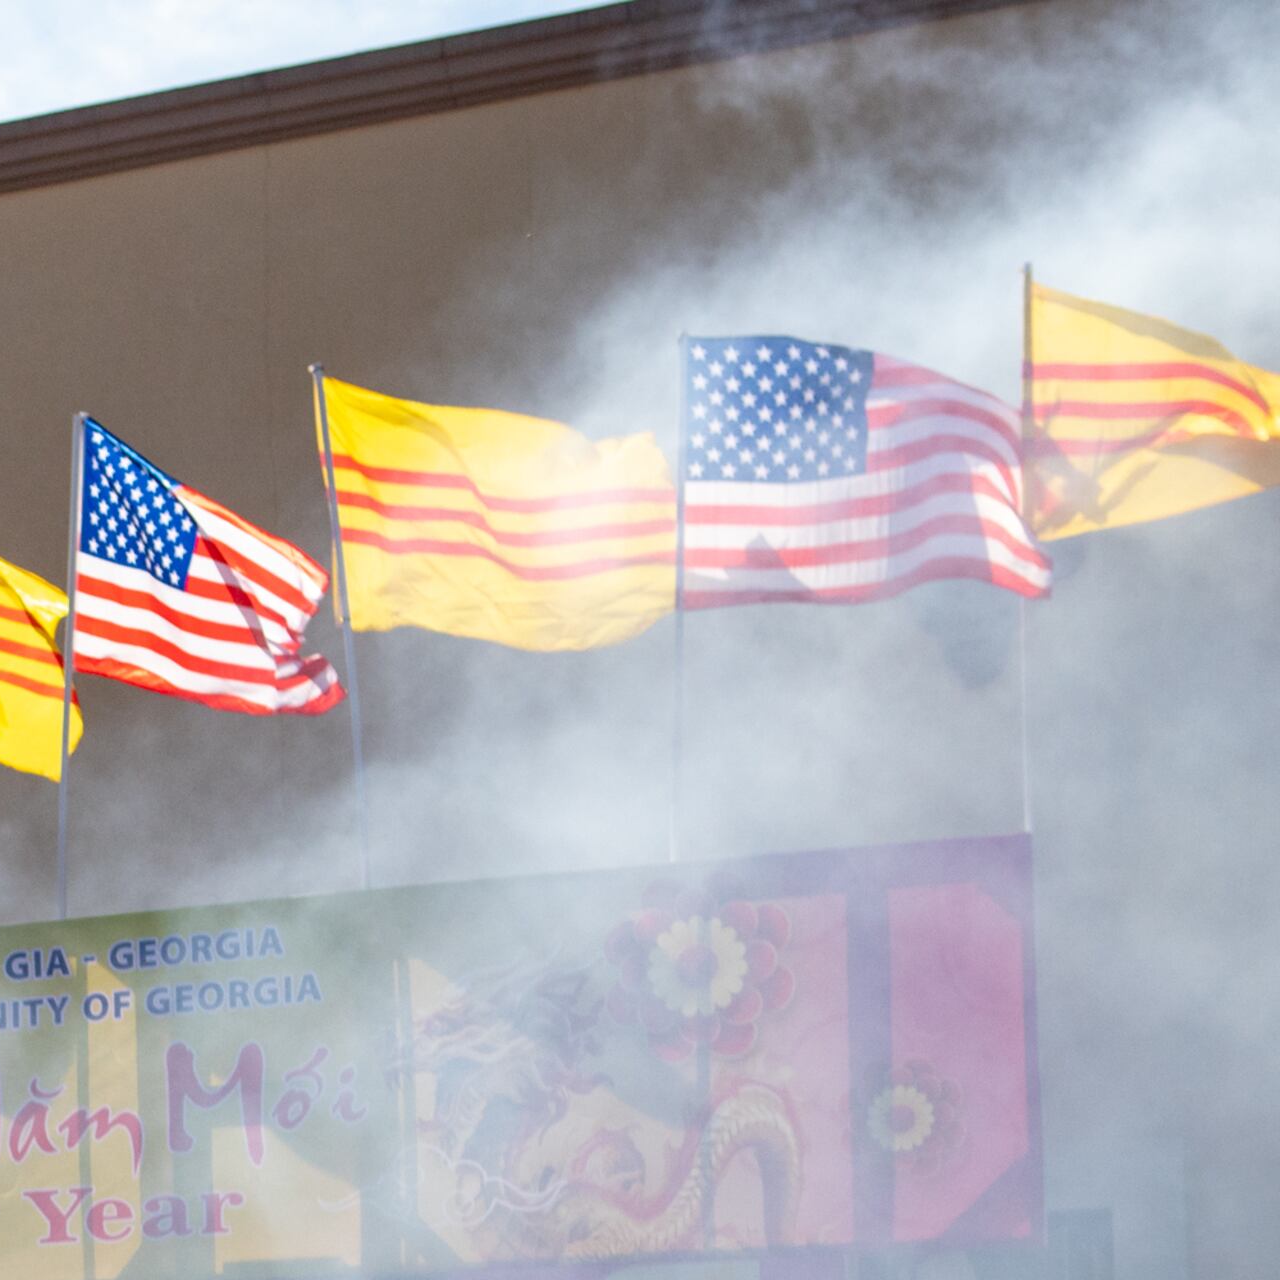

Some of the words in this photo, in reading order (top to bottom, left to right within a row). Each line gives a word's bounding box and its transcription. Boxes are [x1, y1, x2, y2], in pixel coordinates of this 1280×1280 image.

[5, 949, 70, 981] GIA
[109, 928, 284, 971] GEORGIA
[83, 990, 132, 1021] OF
[146, 974, 322, 1016] GEORGIA
[165, 1041, 368, 1166] Mới
[24, 1187, 243, 1245] Year
